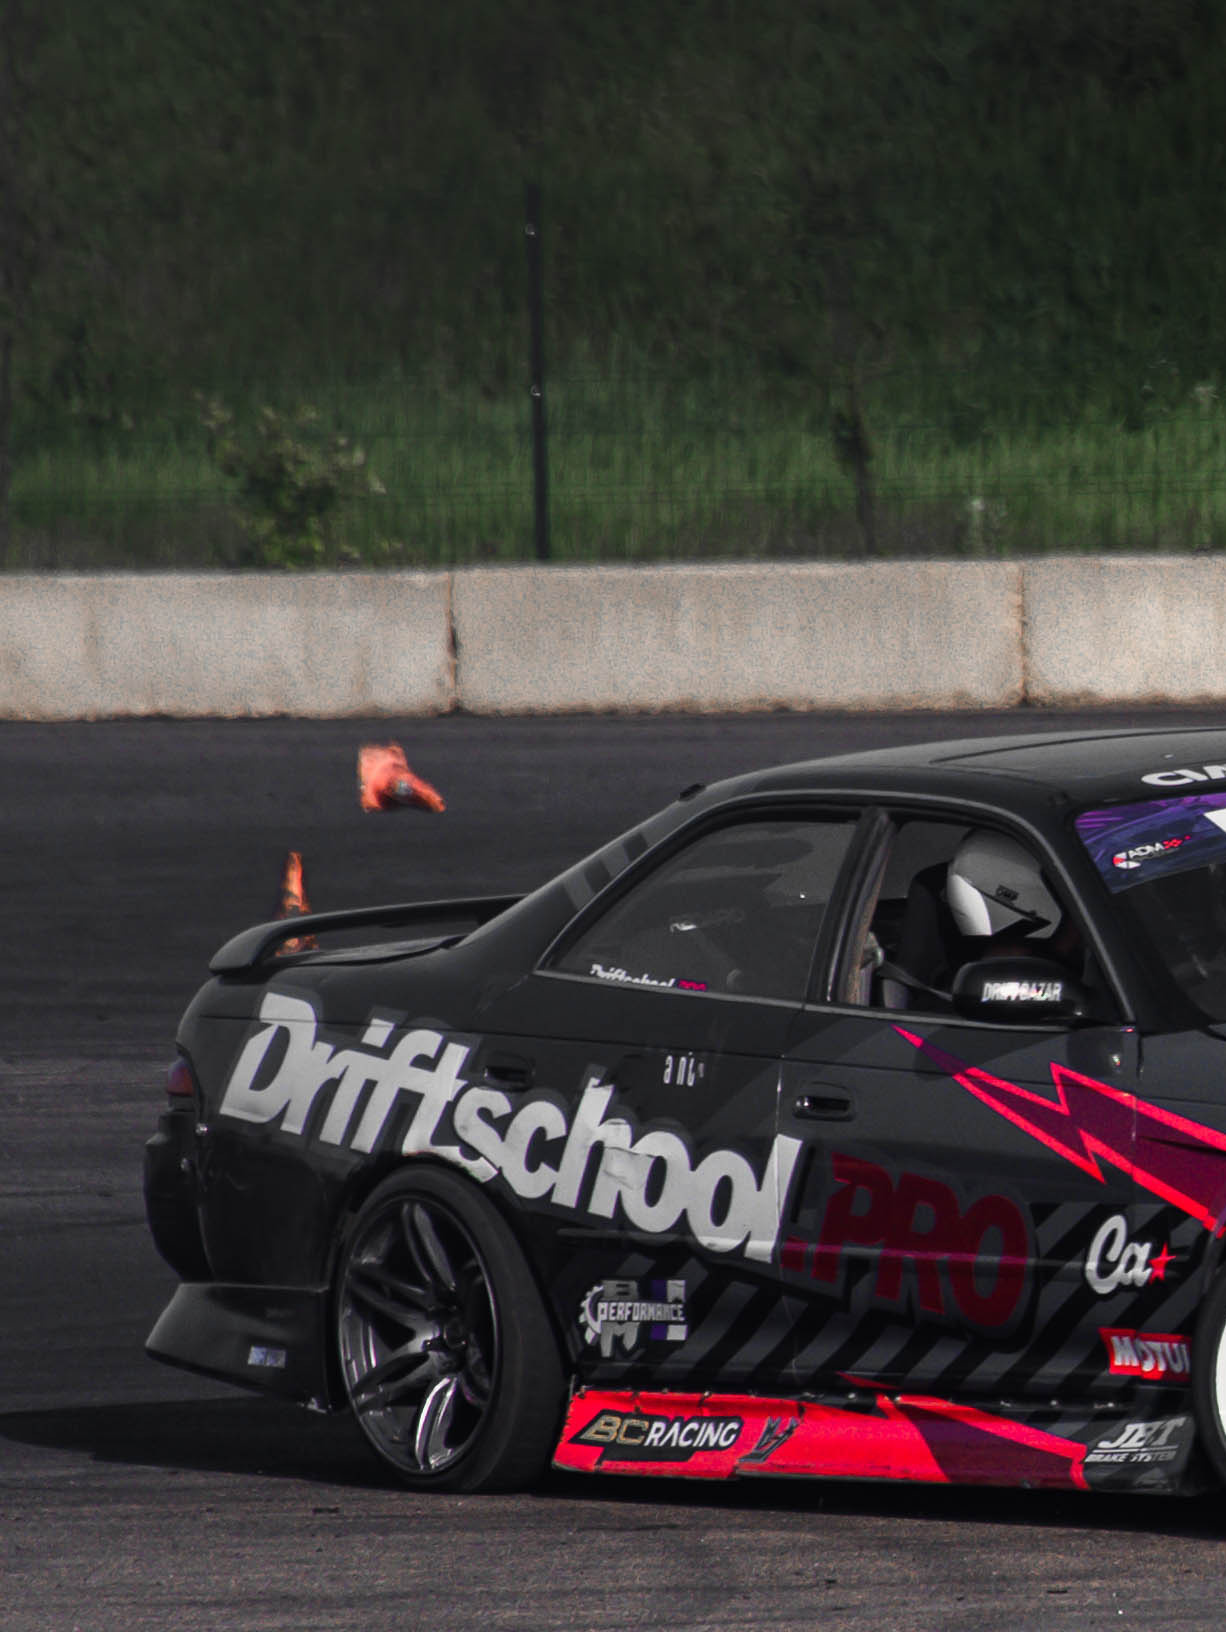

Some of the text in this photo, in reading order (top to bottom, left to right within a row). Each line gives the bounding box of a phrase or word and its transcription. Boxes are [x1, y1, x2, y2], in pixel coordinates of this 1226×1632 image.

[597, 1302, 686, 1321] PERFORMANCE
[1096, 1417, 1187, 1449] JET
[1084, 1453, 1130, 1463] BRAKE
